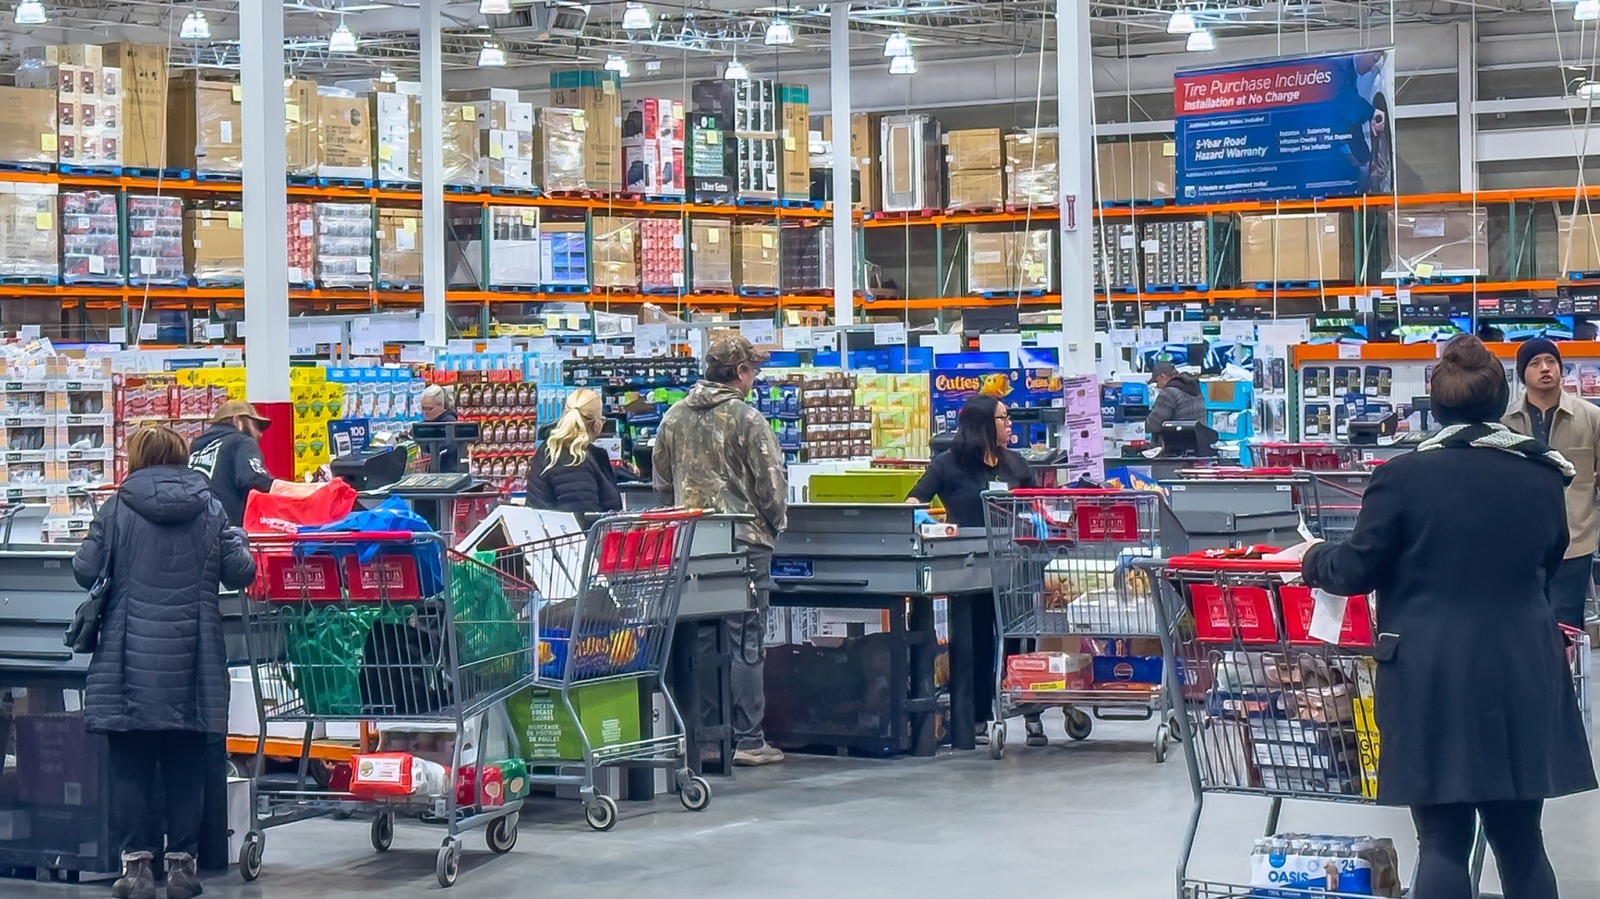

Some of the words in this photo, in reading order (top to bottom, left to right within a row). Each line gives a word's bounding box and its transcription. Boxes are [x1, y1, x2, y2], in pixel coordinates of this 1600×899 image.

[1184, 82, 1207, 98] Tire
[1210, 76, 1271, 96] Purchase
[1275, 69, 1332, 88] Includes
[1184, 95, 1234, 111] Installation
[1236, 95, 1246, 106] at
[1249, 93, 1263, 104] No
[1265, 89, 1300, 103] Charge
[1196, 137, 1222, 150] 5-Year
[1223, 135, 1248, 148] Road
[1195, 148, 1225, 162] Hazard
[1226, 145, 1268, 159] Warranty
[935, 374, 980, 391] Cuties
[946, 410, 957, 419] 100
[350, 426, 366, 437] 100
[1341, 859, 1355, 872] 24
[1268, 870, 1309, 883] OASIS
